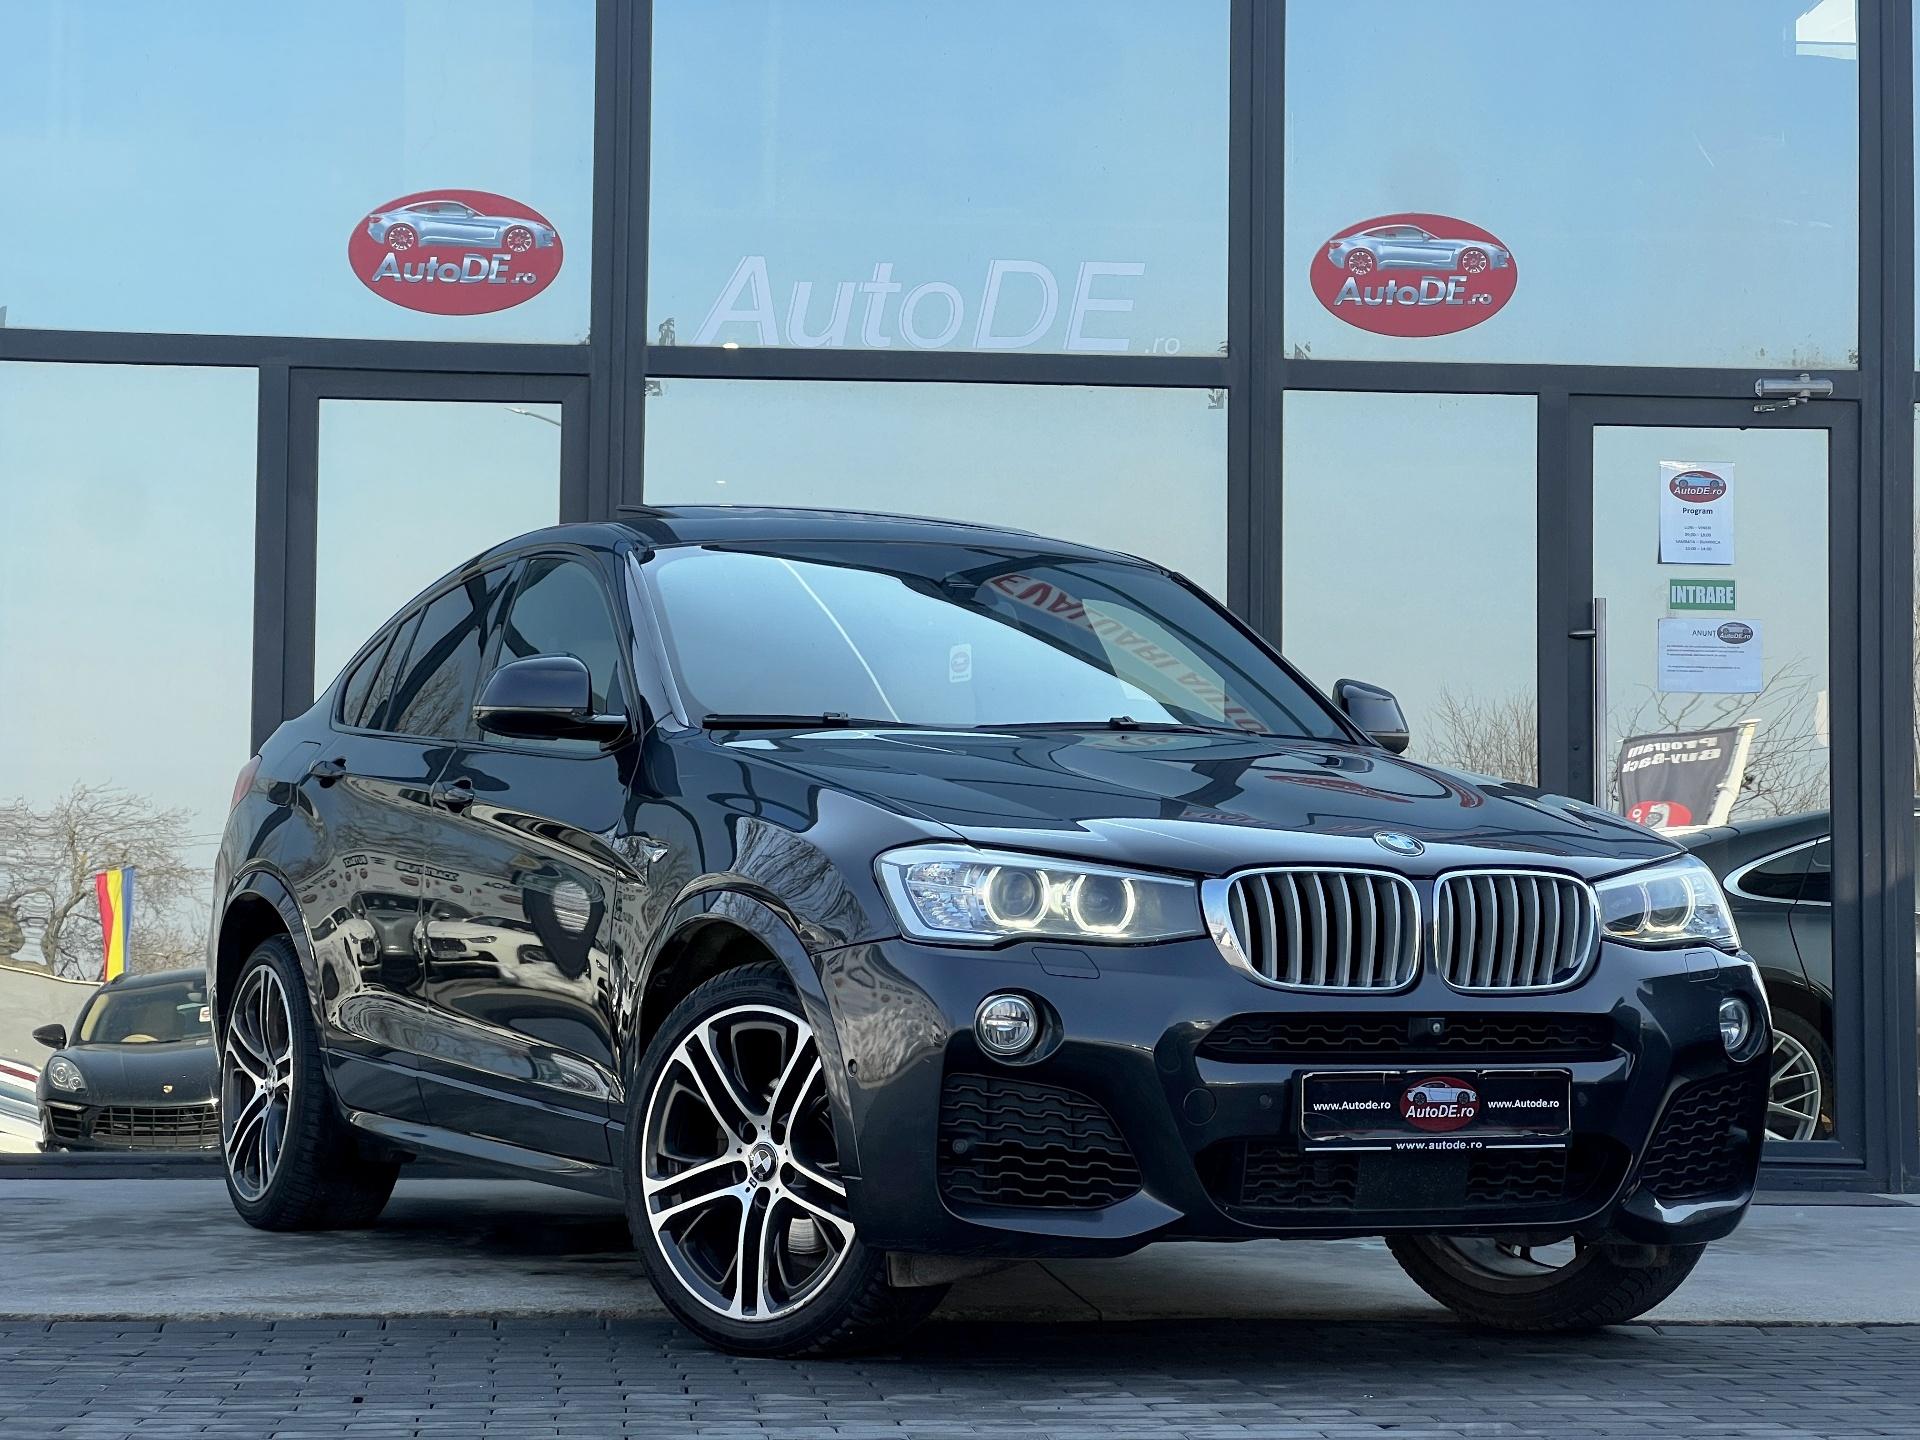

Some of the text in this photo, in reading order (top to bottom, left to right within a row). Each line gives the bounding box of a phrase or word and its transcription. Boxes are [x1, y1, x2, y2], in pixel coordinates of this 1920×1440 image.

[1673, 487, 1722, 495] AutoDE.ro
[1682, 507, 1713, 516] Program
[1671, 585, 1734, 604] INTRARE
[1313, 1100, 1391, 1111] www.Autode.ro
[1487, 1099, 1560, 1109] www.Autode.ro
[1405, 1104, 1475, 1118] AutoDE.ro
[1396, 1140, 1483, 1150] www.autode.ro
